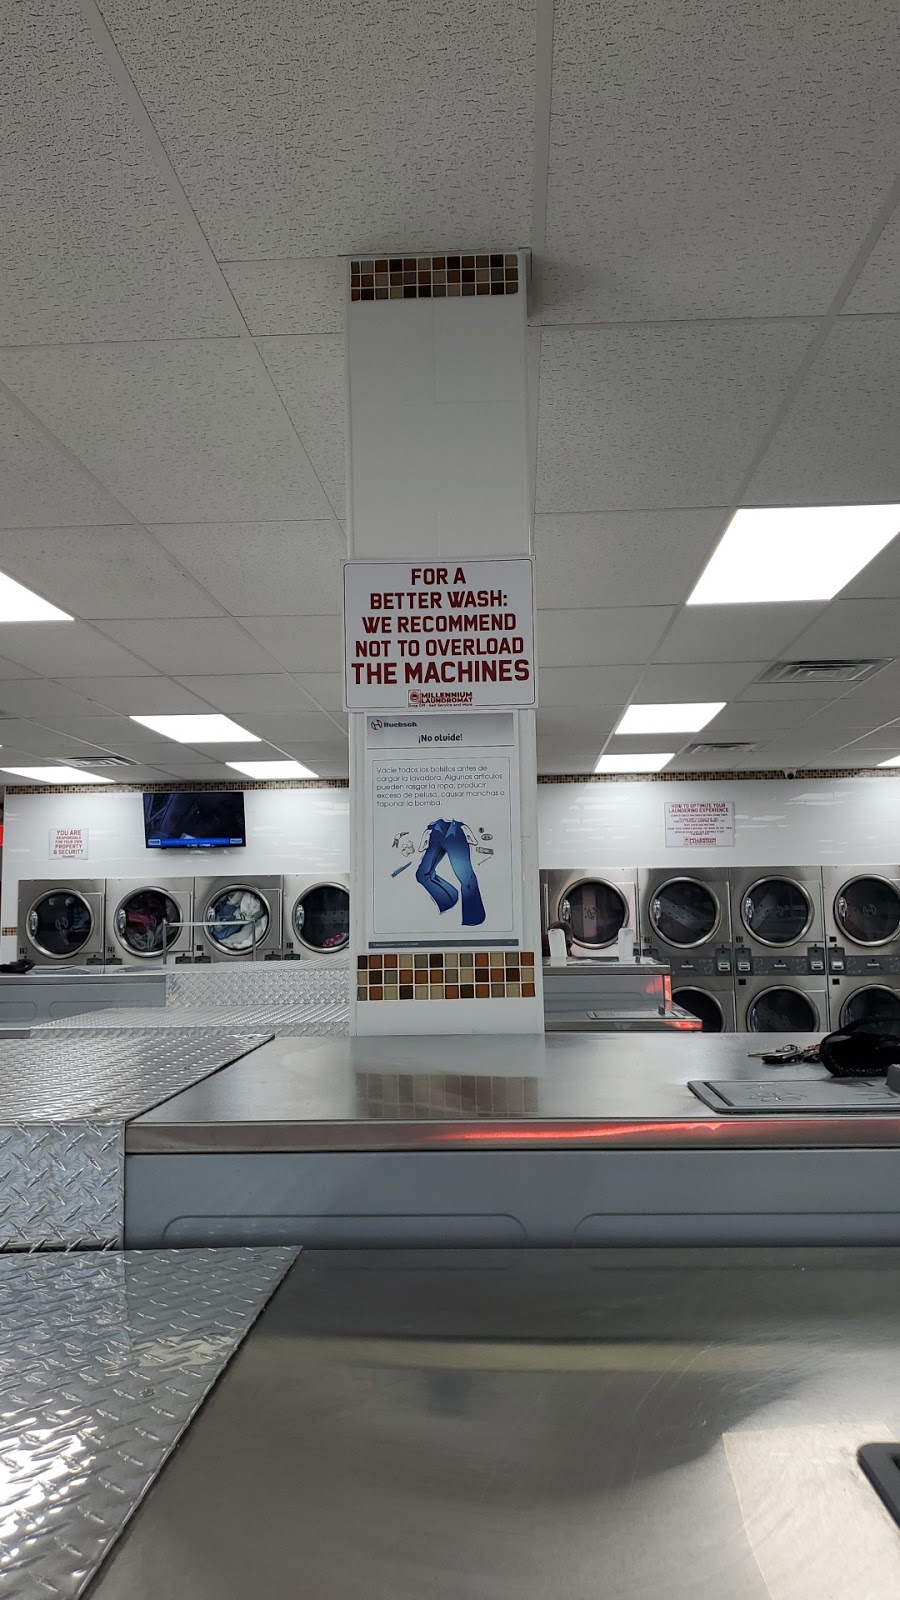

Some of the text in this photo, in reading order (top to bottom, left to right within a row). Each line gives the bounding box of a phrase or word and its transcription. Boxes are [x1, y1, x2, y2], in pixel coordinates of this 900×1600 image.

[411, 567, 466, 585] FOR A
[370, 590, 508, 609] BETTER WASH:
[362, 613, 516, 633] WE RECOMMEND
[356, 637, 524, 657] NOT TO OVERLOAD
[351, 659, 529, 685] THE MACHINES
[418, 734, 463, 743] ¡No olvide!
